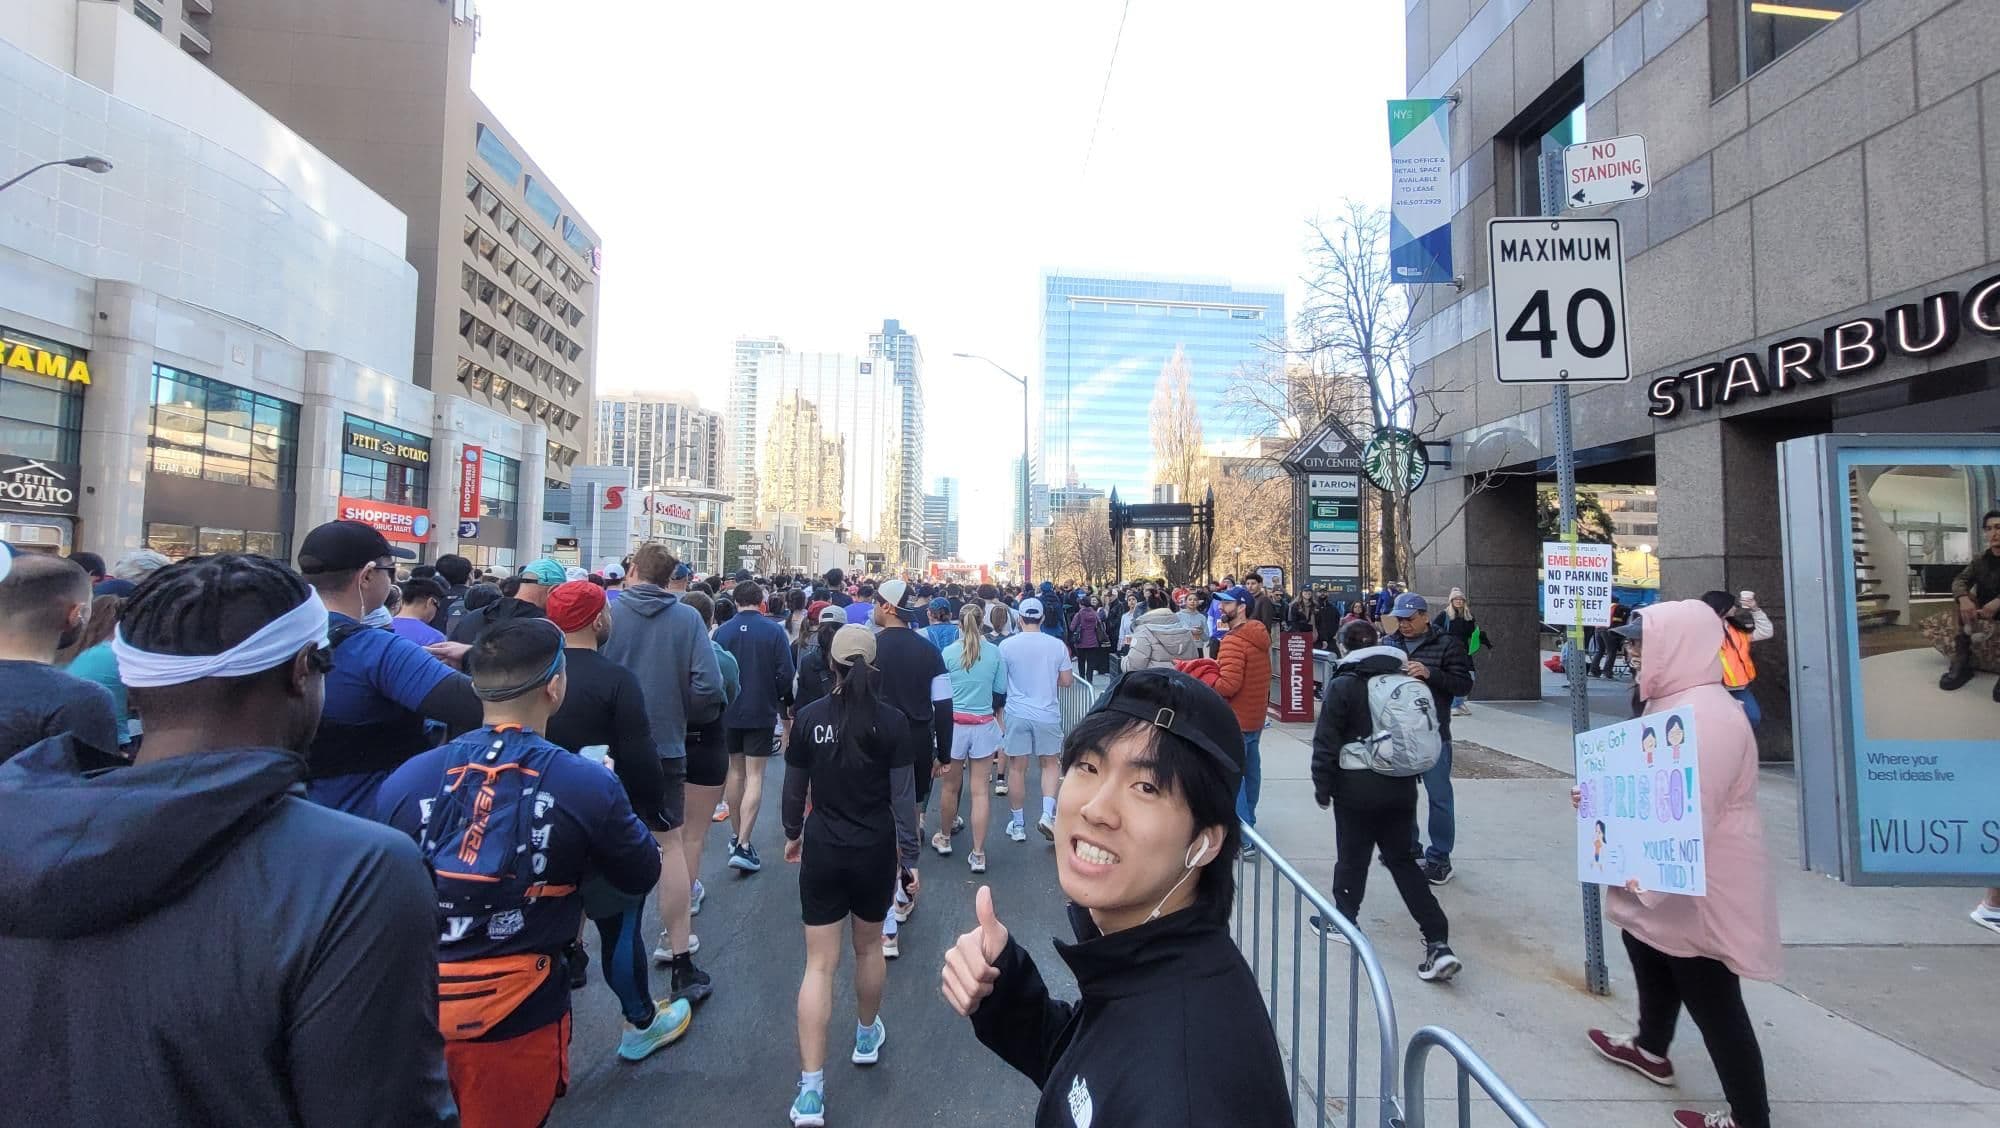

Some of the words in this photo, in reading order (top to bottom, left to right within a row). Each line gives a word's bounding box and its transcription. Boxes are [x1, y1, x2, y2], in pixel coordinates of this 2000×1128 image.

[1592, 143, 1616, 160] NO
[1571, 159, 1642, 184] STANDING
[1501, 238, 1611, 262] MAXIMUM
[1506, 288, 1615, 359] 40
[0, 341, 91, 385] AMA
[352, 432, 380, 451] PETIT
[397, 445, 429, 463] POTATO
[1304, 457, 1325, 467] CITY
[1326, 457, 1361, 468] CENTRE
[15, 472, 55, 487] PETIT
[464, 463, 472, 513] SHOPPERS
[1319, 480, 1356, 489] TARION
[0, 481, 73, 503] POTATO
[344, 507, 413, 526] SHOPPERS
[373, 523, 393, 532] DRUG
[393, 524, 412, 533] MART
[1548, 569, 1561, 581] NO
[1565, 570, 1609, 583] PARKING
[1548, 585, 1560, 595] ON
[1563, 585, 1585, 596] THIS
[1587, 586, 1609, 597] SIDE
[1553, 599, 1565, 609] OF
[1290, 664, 1304, 710] FREE
[1867, 752, 1910, 765] Where
[1911, 754, 1939, 767] your
[1867, 769, 1898, 781] best
[1899, 769, 1933, 781] ideas
[1934, 769, 1955, 781] live
[1869, 818, 1969, 855] MUST
[1678, 838, 1701, 863] NOT
